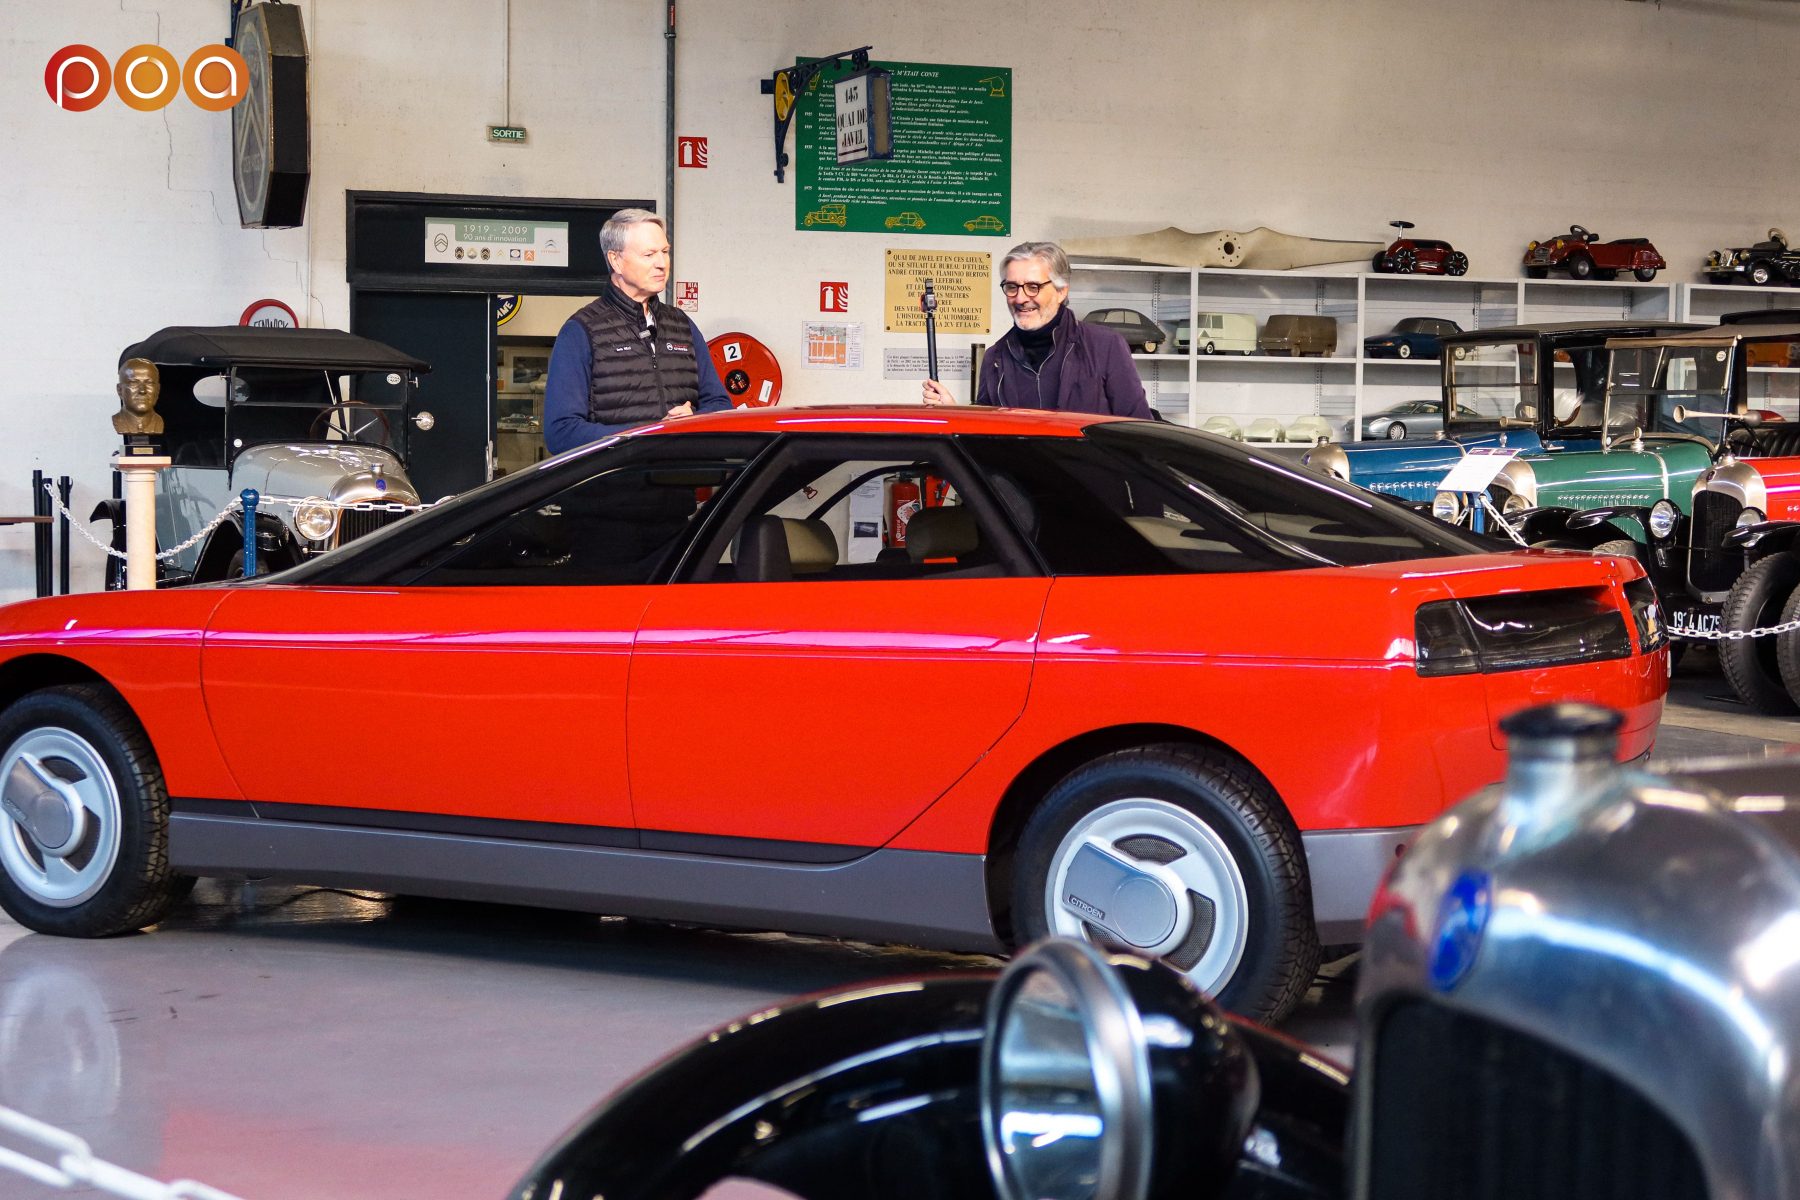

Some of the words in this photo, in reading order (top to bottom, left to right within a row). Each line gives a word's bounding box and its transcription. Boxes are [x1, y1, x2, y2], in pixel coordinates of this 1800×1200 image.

[845, 86, 858, 103] 145
[837, 111, 855, 131] QUAI
[857, 108, 867, 124] DE
[493, 129, 523, 138] SORTIE
[842, 129, 864, 147] JAVEL
[464, 225, 490, 233] 1919
[502, 226, 528, 234] 2009
[728, 346, 738, 359] 2
[1673, 611, 1695, 630] 194
[1071, 898, 1103, 918] CITROEN
